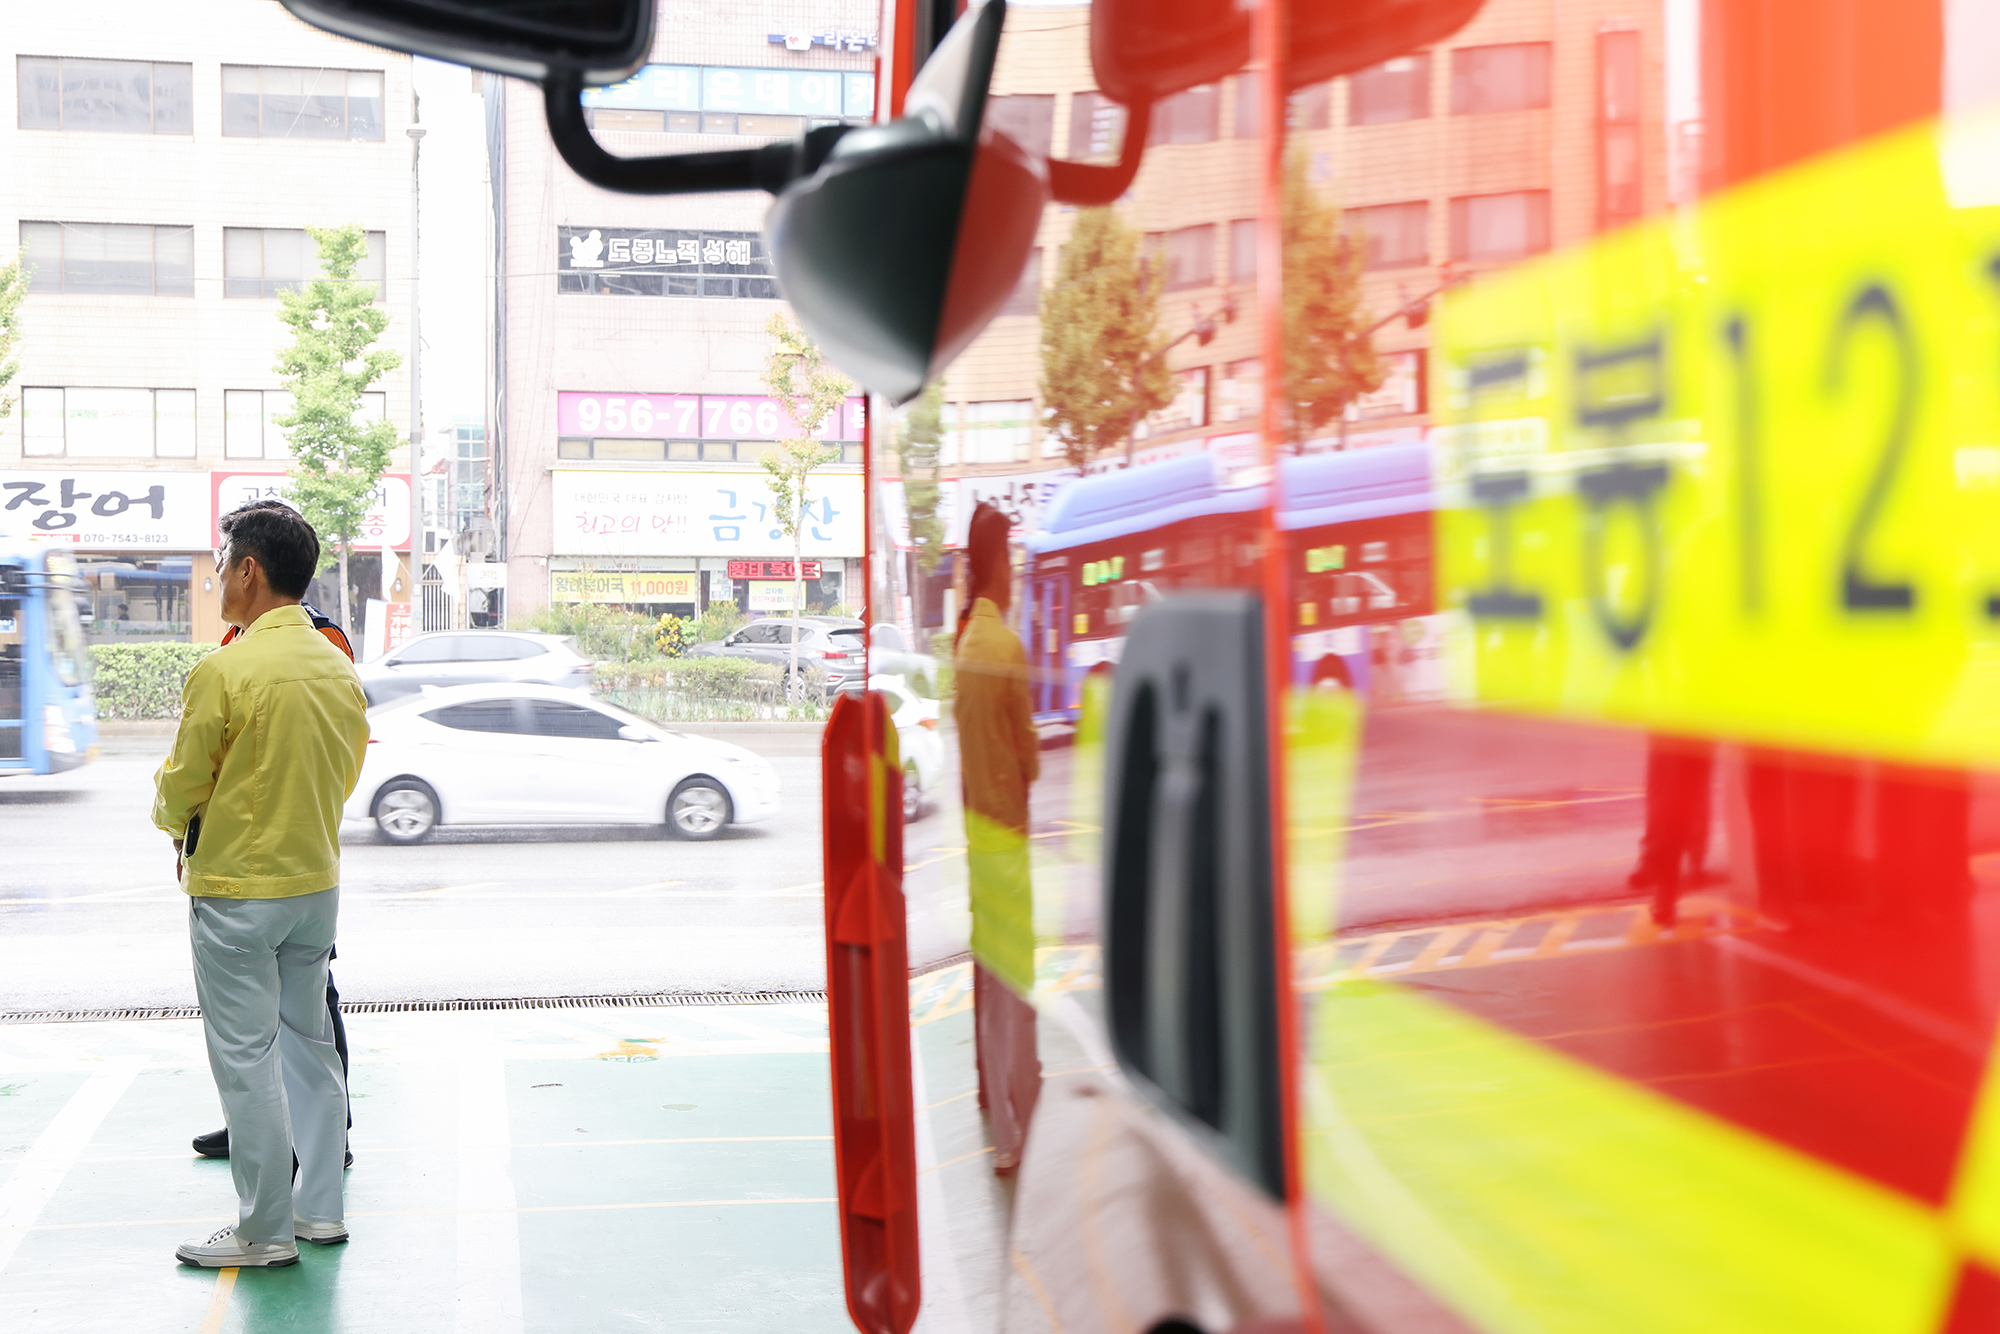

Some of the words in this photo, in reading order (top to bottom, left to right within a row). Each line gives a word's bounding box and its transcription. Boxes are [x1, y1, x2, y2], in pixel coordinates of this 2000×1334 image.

[577, 398, 778, 435] 956-7766
[3, 479, 164, 530] 장어
[574, 492, 621, 504] 대한민국
[626, 493, 648, 503] 대표
[655, 493, 687, 505] 감자탕
[575, 511, 641, 535] 최고의
[652, 514, 687, 535] 맛!!
[83, 533, 169, 543] 070-7543-8123
[630, 580, 688, 597] 11,000원
